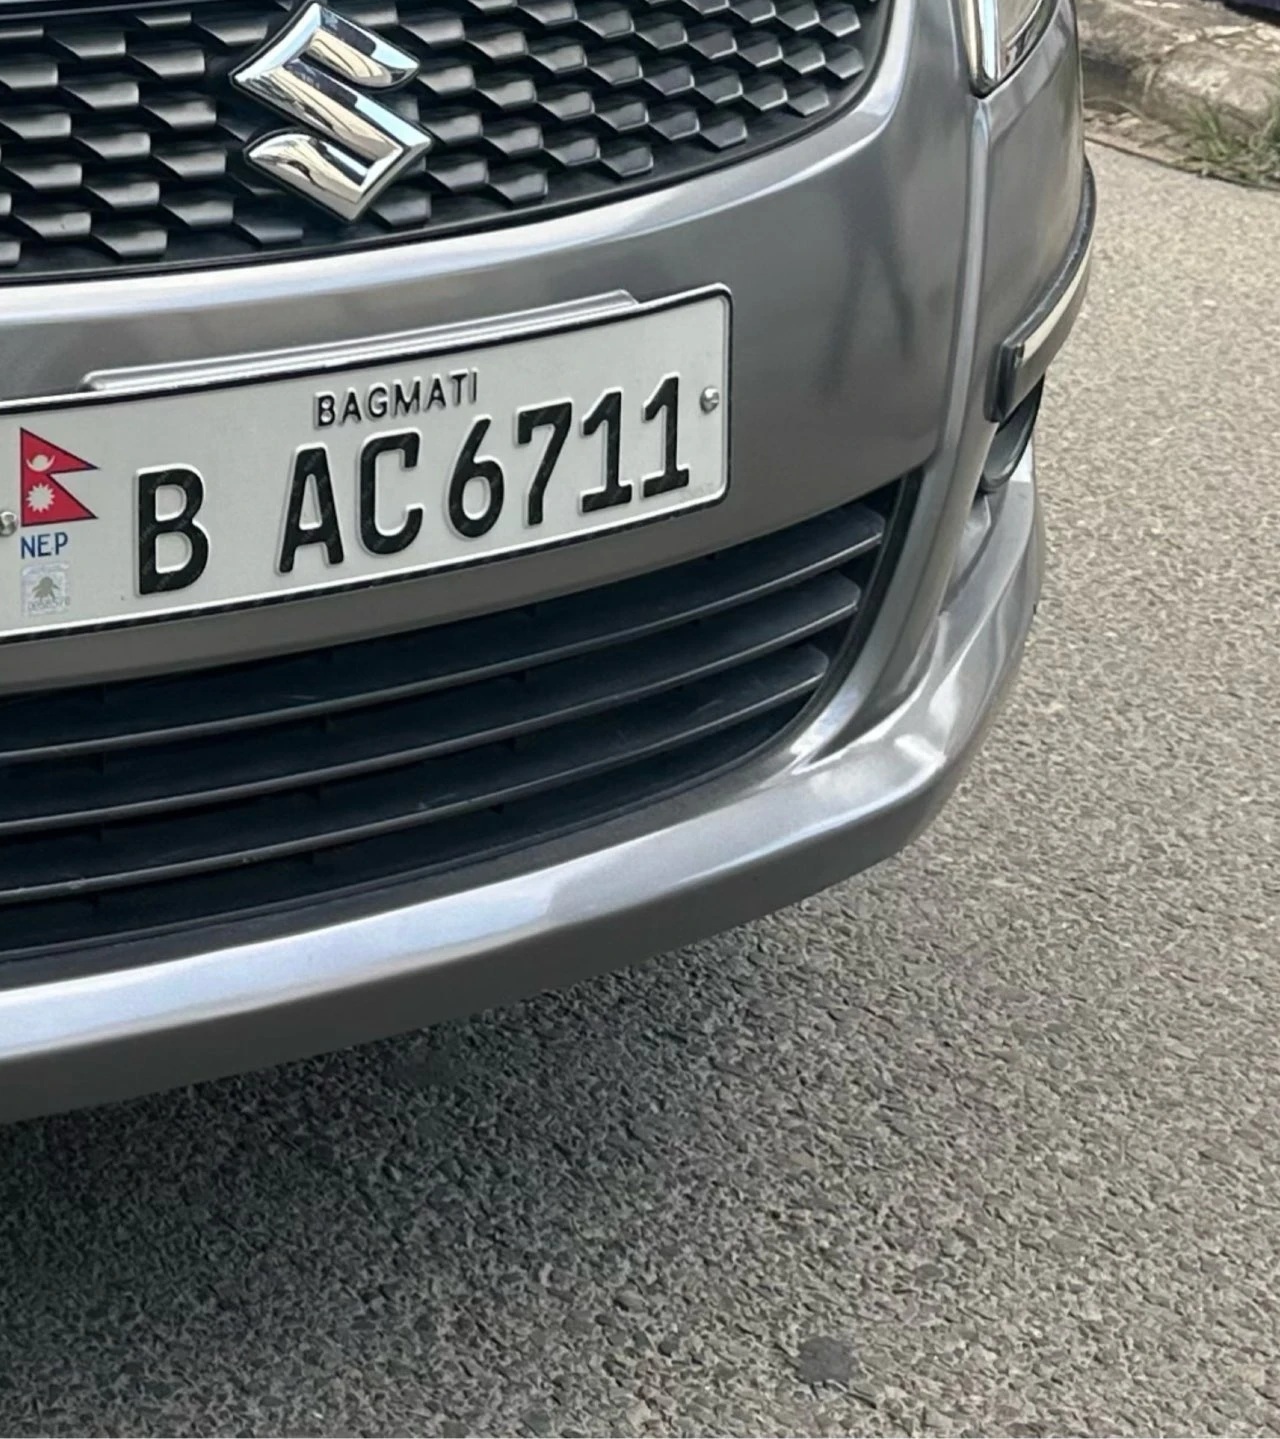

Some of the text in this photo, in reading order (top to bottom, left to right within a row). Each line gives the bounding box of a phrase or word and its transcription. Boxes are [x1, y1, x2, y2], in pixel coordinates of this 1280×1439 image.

[317, 371, 478, 427] BAGMATI
[21, 531, 69, 560] NEP
[139, 468, 208, 596] B
